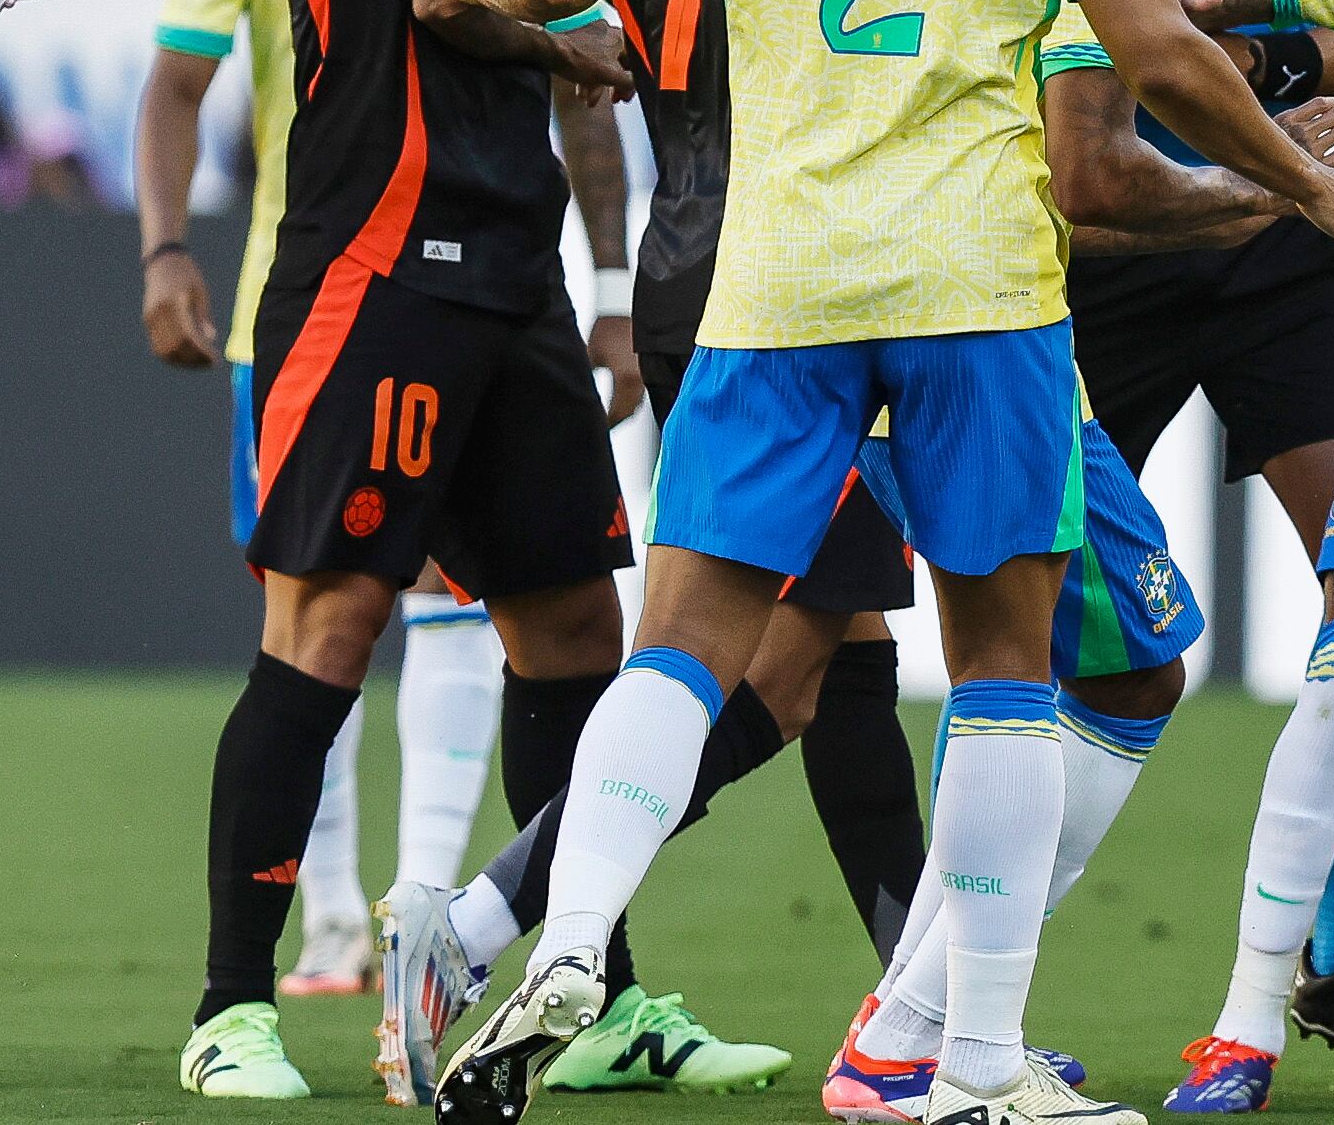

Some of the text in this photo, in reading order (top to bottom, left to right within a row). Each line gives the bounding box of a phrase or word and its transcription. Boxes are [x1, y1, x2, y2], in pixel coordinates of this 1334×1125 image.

[370, 377, 439, 478] 10
[599, 778, 669, 829] BRASIL
[939, 870, 1011, 896] BRASIL
